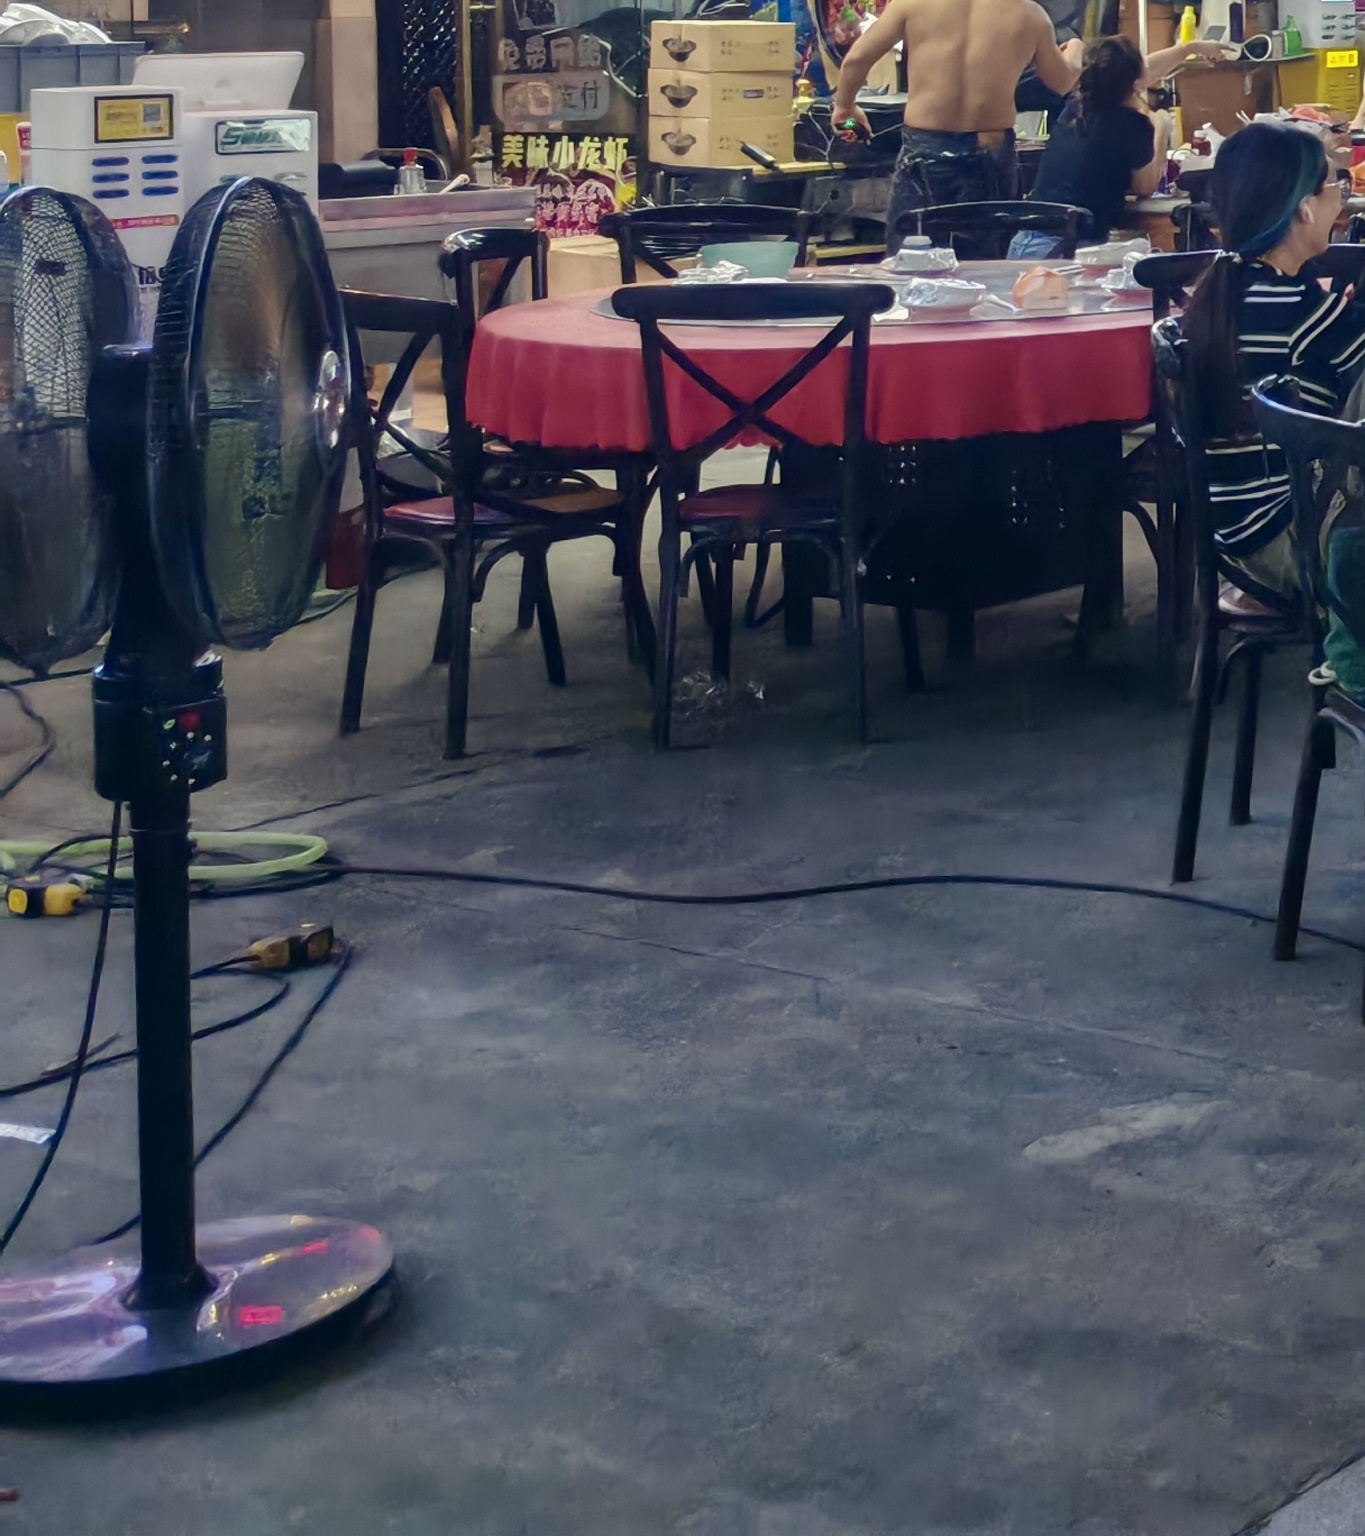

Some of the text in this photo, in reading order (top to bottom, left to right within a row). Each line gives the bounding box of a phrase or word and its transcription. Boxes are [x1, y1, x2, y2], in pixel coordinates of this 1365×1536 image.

[502, 134, 629, 170] 美味小龙虾
